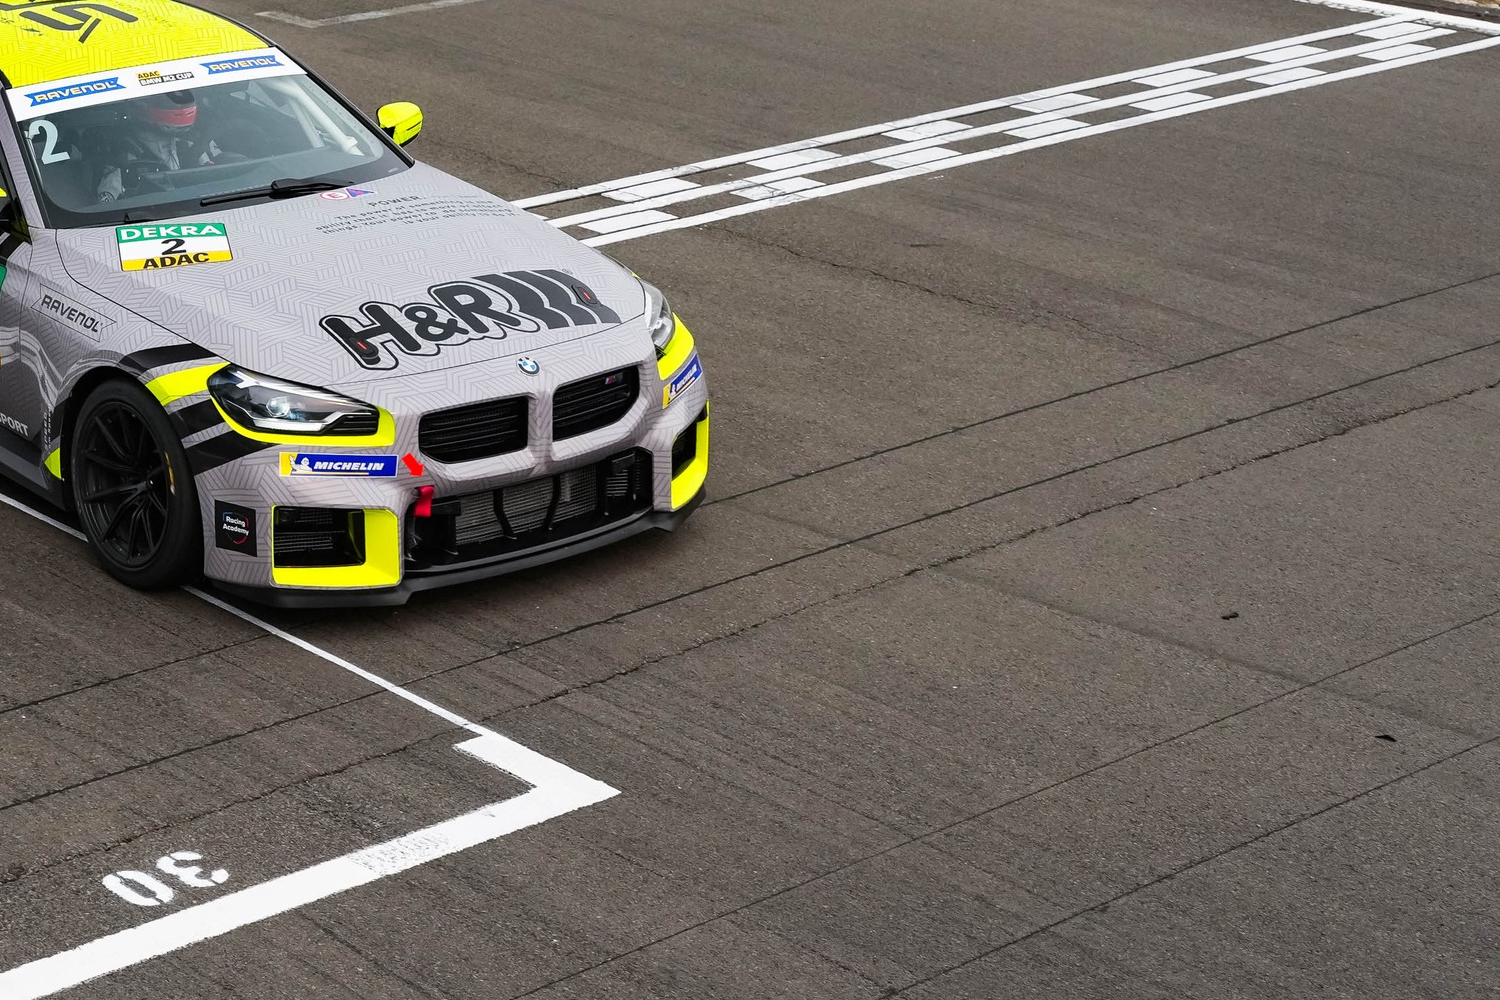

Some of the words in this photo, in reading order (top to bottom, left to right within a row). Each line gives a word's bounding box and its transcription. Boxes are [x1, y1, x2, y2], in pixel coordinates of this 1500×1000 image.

[209, 58, 276, 73] RAVENOL
[137, 71, 160, 79] ADAC
[140, 77, 162, 86] BMW
[33, 81, 116, 103] RAVENOL
[29, 119, 71, 165] 2
[121, 225, 222, 240] DEKRA
[161, 238, 187, 256] 2
[143, 252, 209, 269] ADAC
[41, 294, 102, 333] RAVENOL
[319, 280, 541, 370] H&R
[313, 460, 385, 471] MICHELIN
[225, 515, 247, 528] Racing
[222, 523, 250, 536] Academy
